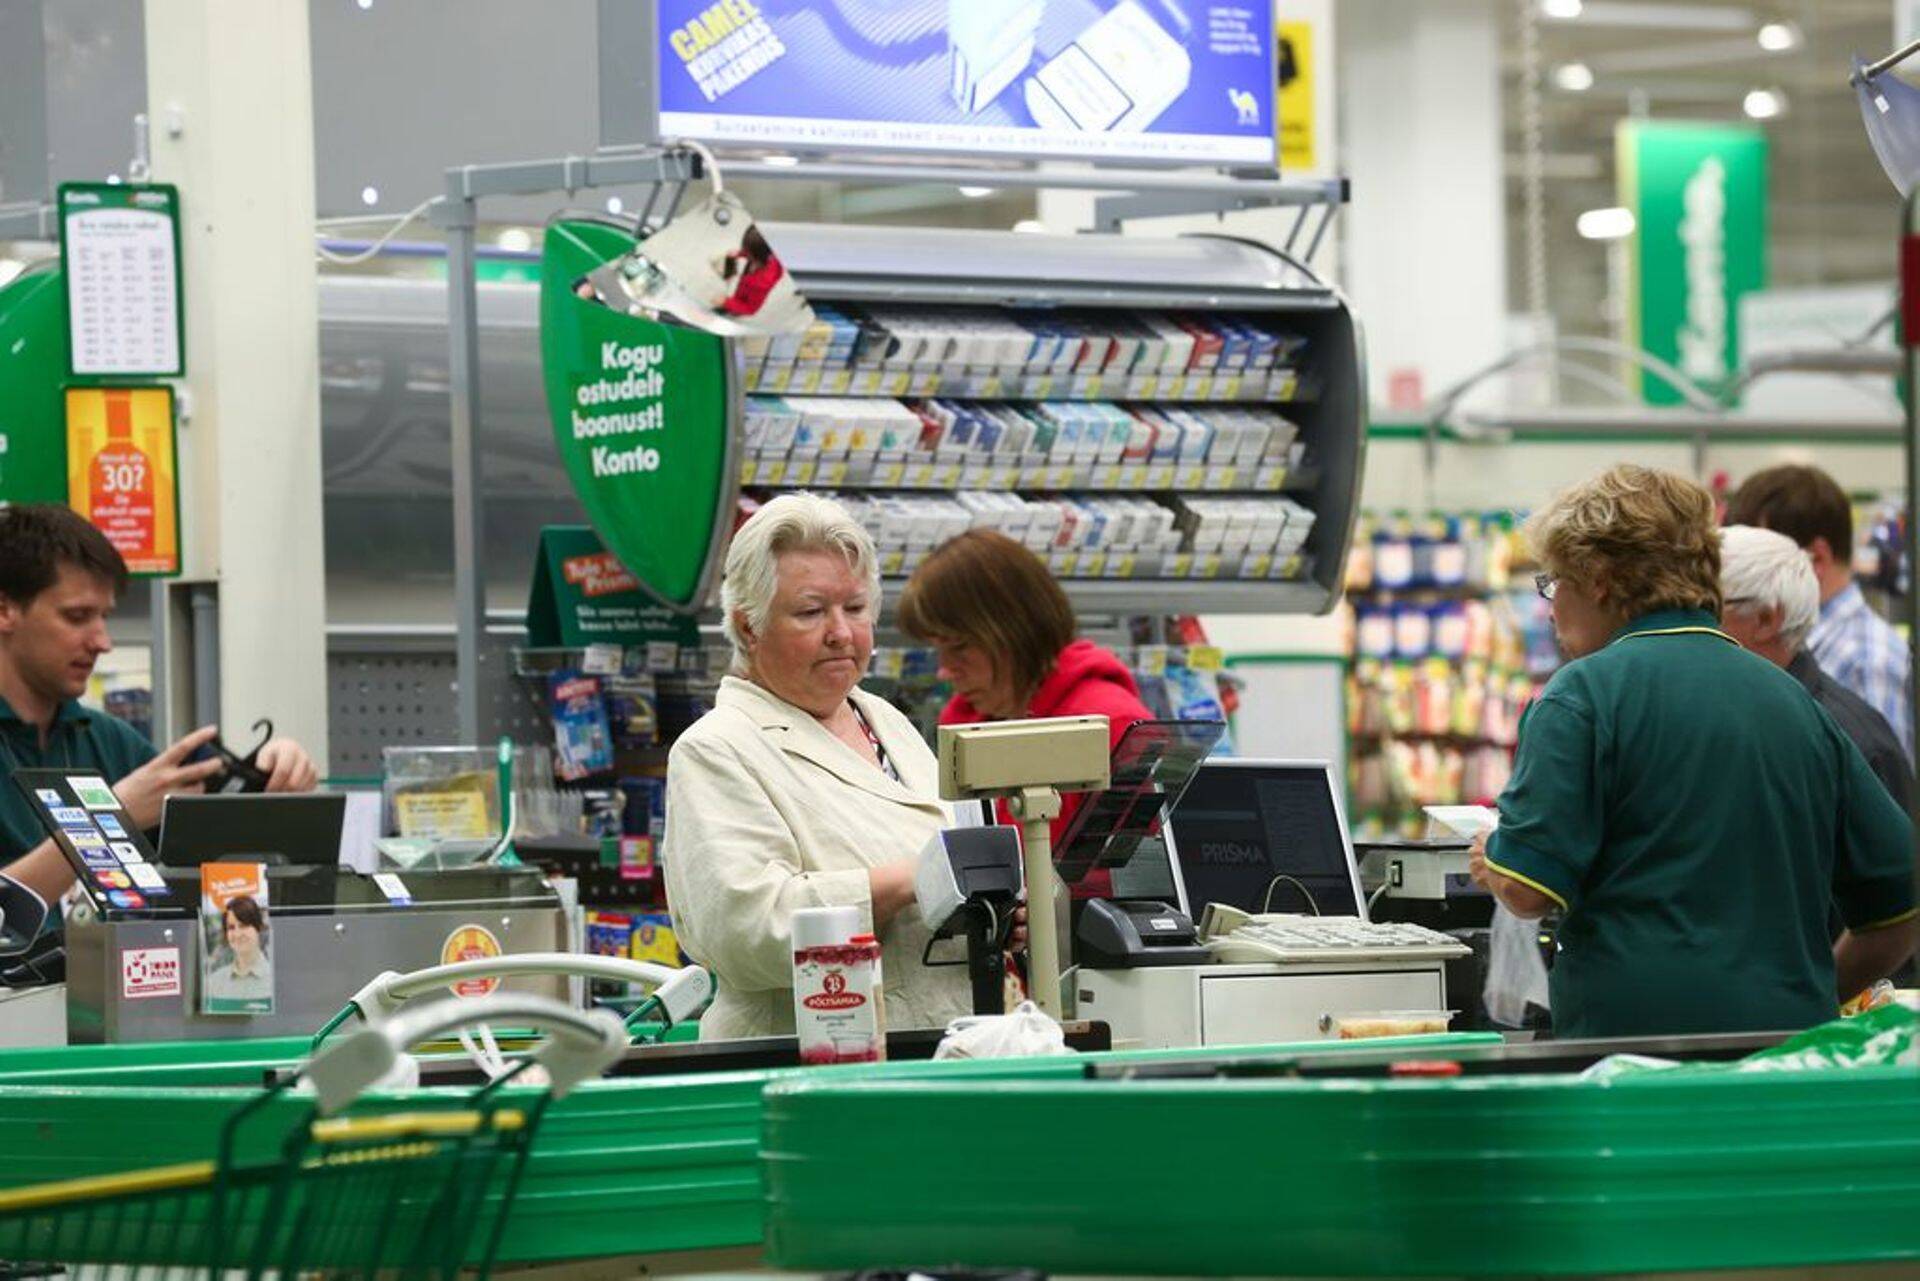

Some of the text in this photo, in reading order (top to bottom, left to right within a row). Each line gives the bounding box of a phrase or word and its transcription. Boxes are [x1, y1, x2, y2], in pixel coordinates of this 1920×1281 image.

[669, 0, 759, 62] CAMEL
[602, 341, 664, 373] Kogu
[577, 367, 664, 406] ostudelt
[571, 401, 664, 440] boonust!
[591, 445, 660, 478] Konto
[101, 463, 145, 493] 30?
[59, 811, 85, 819] VISA
[1202, 842, 1266, 865] PRISMA
